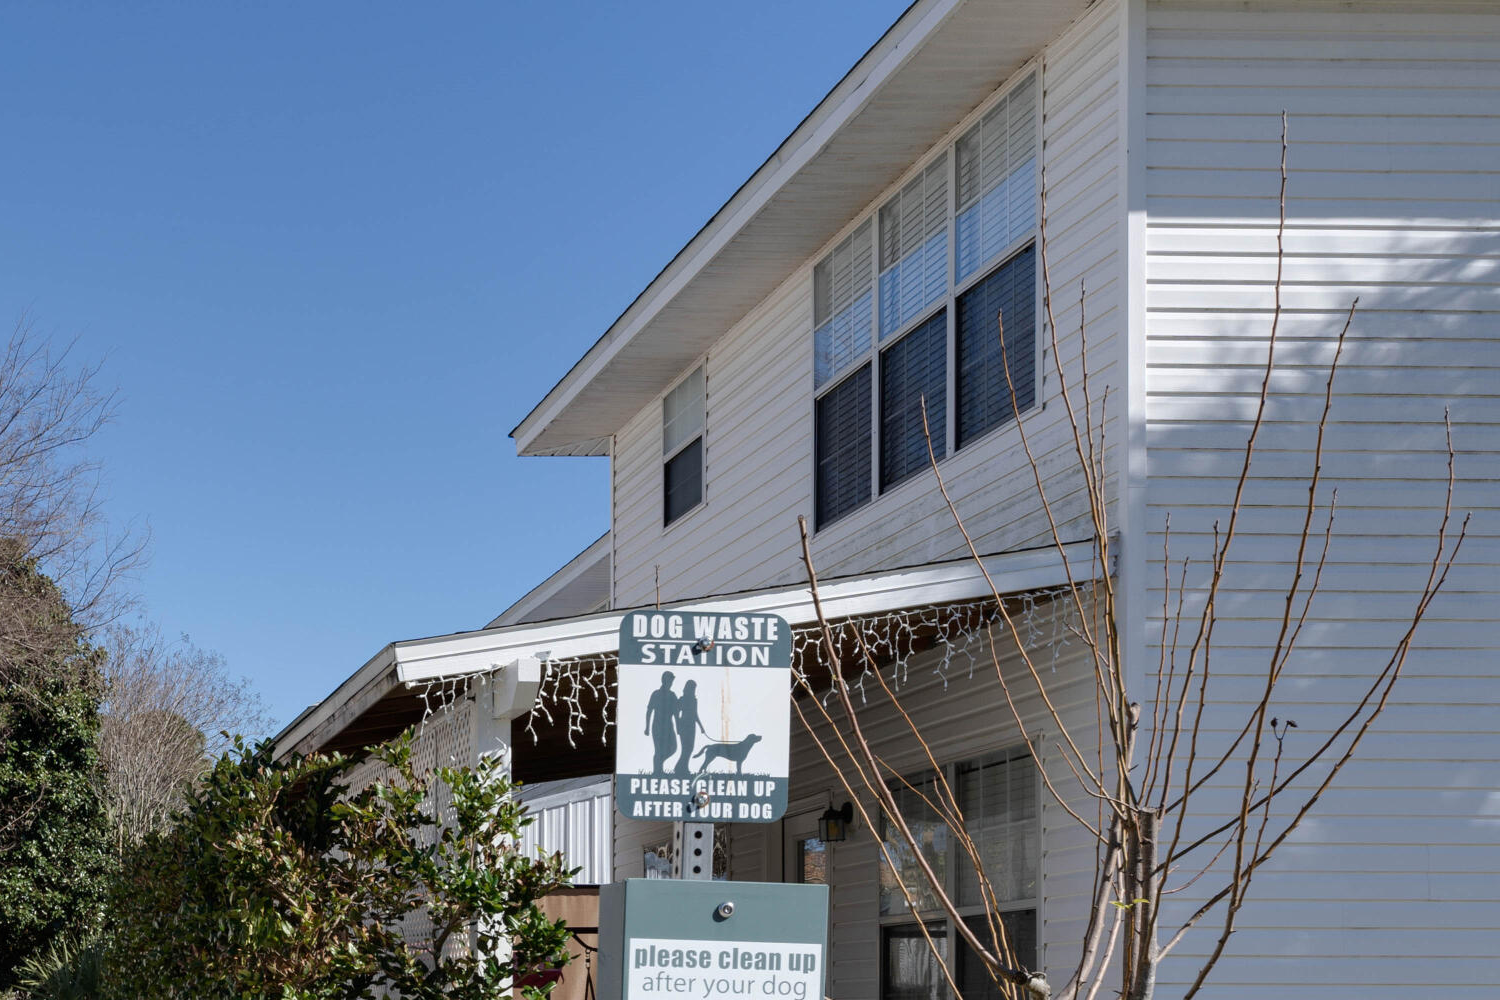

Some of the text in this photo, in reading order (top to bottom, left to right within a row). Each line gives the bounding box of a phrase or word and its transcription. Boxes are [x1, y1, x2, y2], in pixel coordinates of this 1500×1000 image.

[633, 614, 779, 641] DOG WASTE
[630, 778, 776, 797] PLEASE CLEAN UP
[633, 801, 773, 820] AFTER YOUR DOG
[634, 945, 816, 974] please clean up
[642, 971, 807, 1000] after your dog
